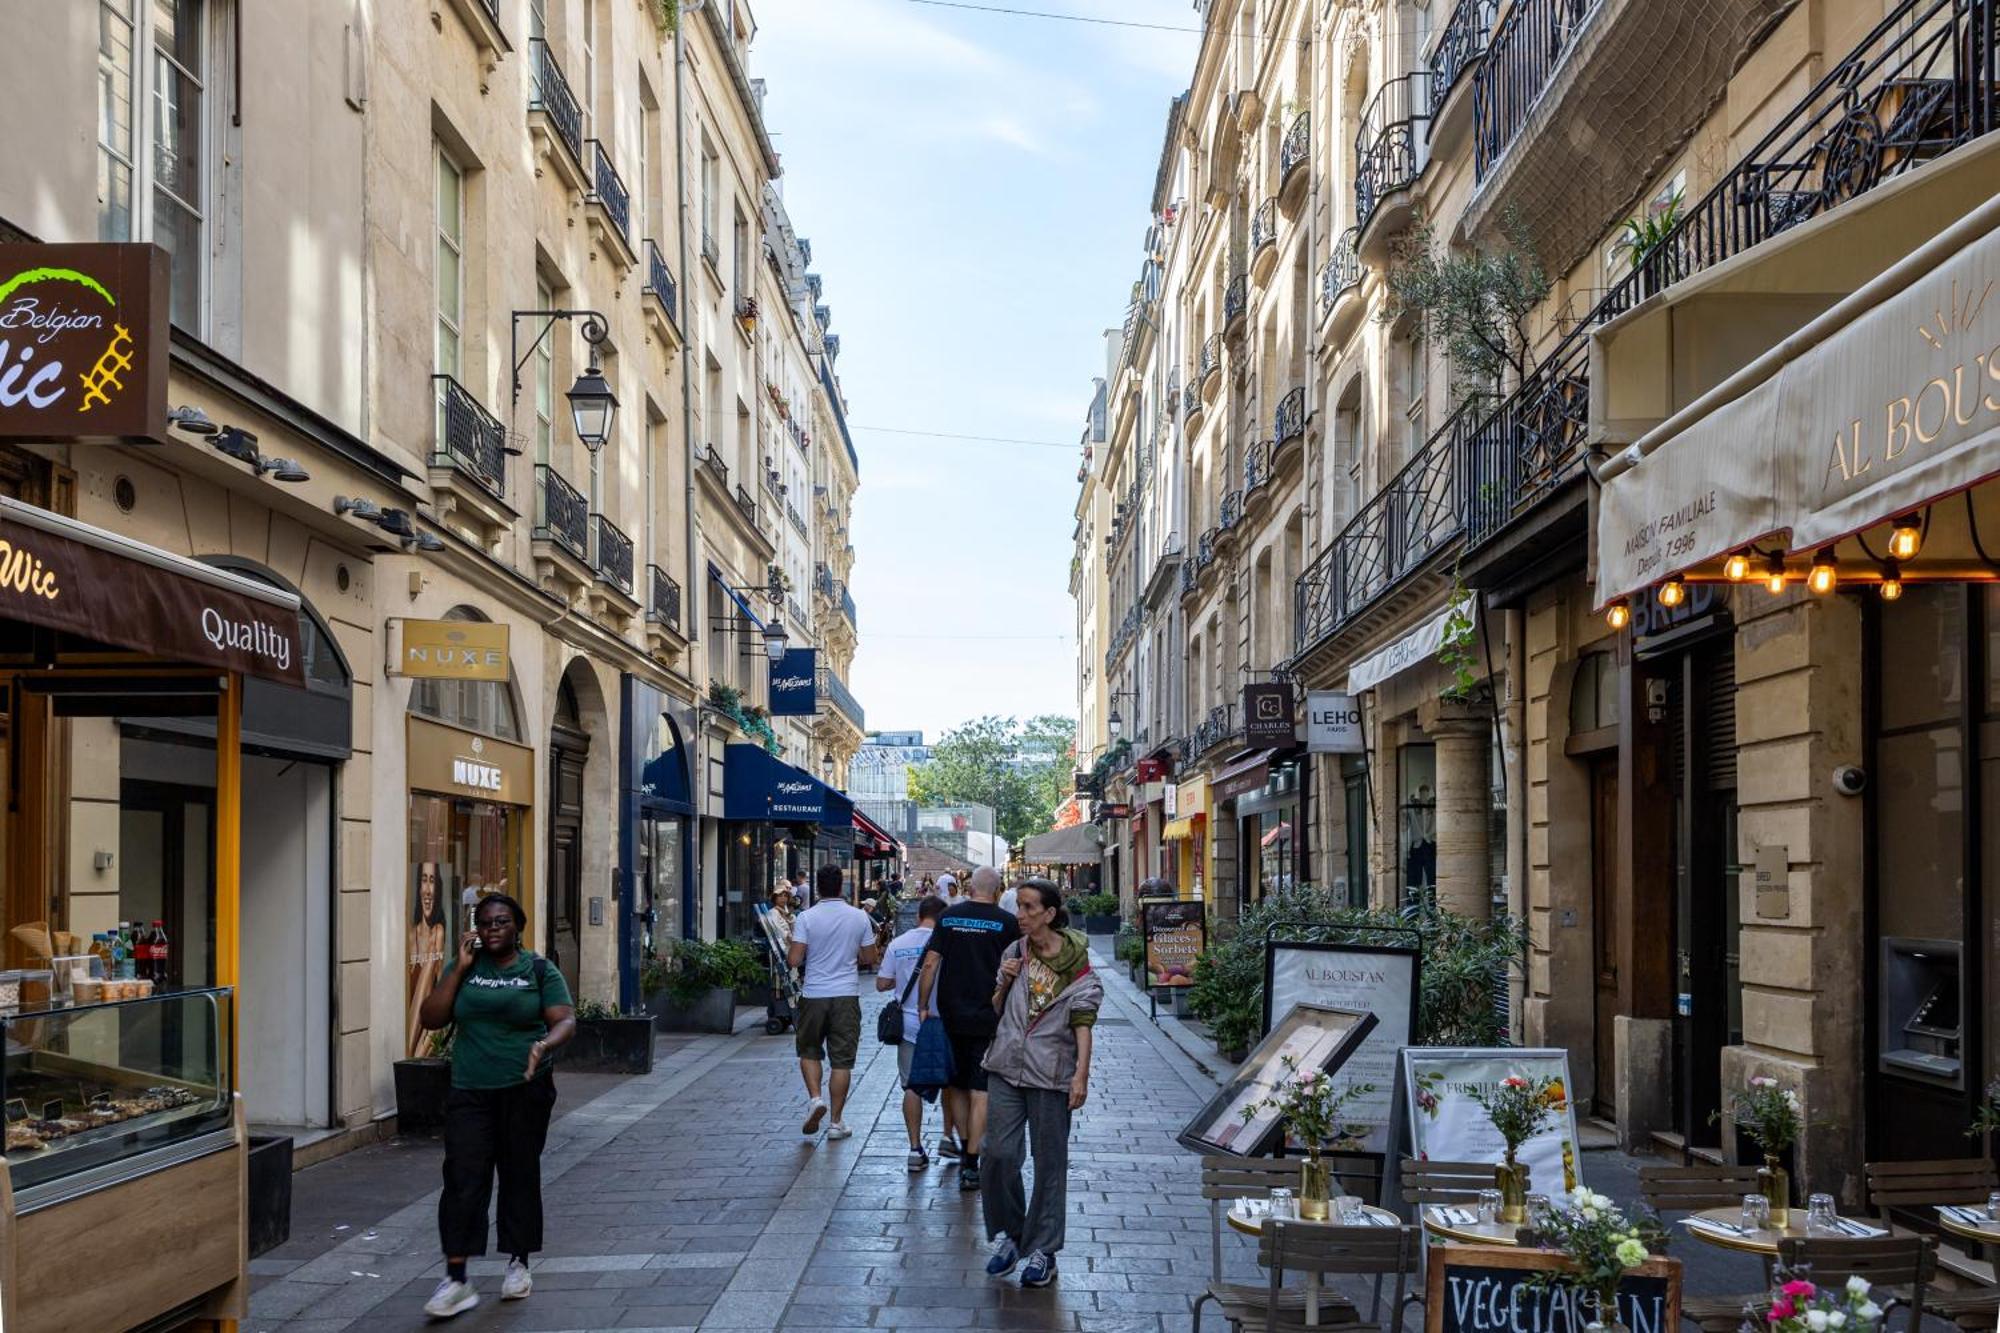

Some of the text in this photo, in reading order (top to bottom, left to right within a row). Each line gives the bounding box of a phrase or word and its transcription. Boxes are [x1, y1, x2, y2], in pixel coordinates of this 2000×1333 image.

[0, 298, 102, 343] Belgian
[0, 340, 66, 409] ic
[1823, 419, 1872, 491] AL
[1624, 490, 1716, 557] MAISON FAMILIALE
[1637, 531, 1696, 576] Depuis 1996
[202, 607, 290, 670] Quality
[409, 648, 502, 665] NUXE
[454, 760, 502, 790] NUXE
[773, 804, 822, 813] RESTAURANT
[1153, 933, 1191, 943] Glaces
[1153, 944, 1198, 954] Sorbets
[1446, 1081, 1489, 1094] FRESH
